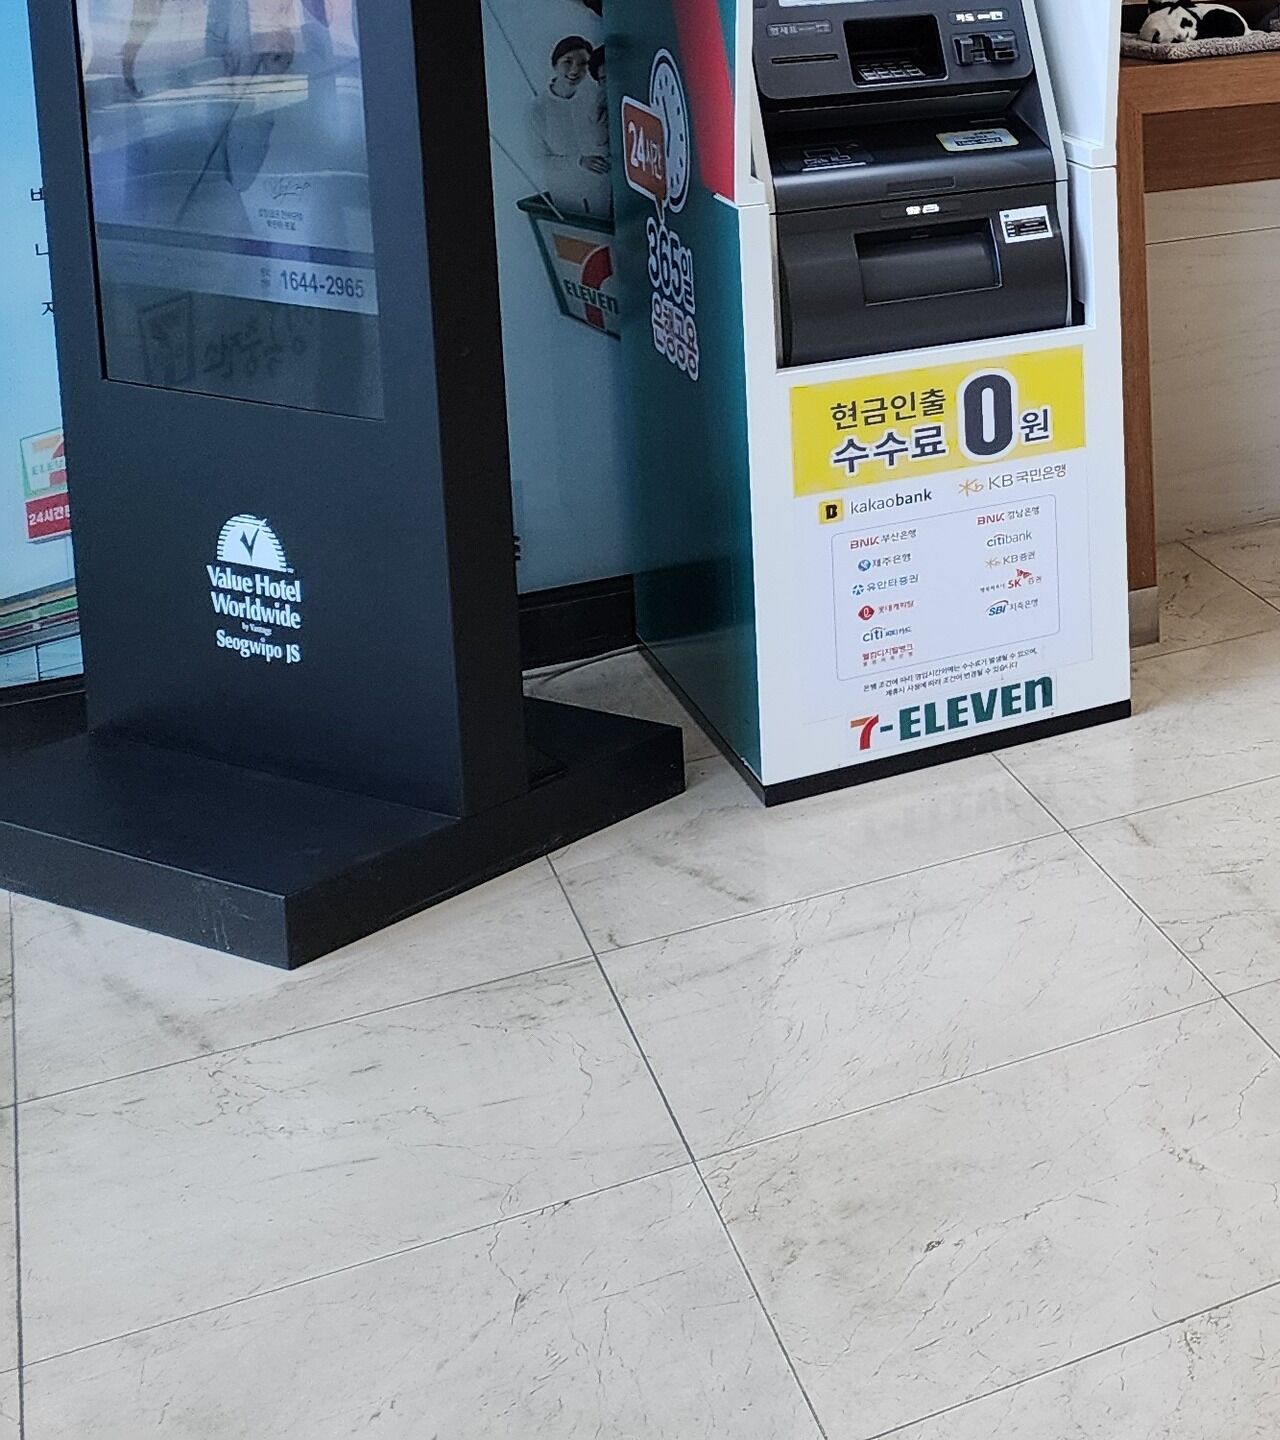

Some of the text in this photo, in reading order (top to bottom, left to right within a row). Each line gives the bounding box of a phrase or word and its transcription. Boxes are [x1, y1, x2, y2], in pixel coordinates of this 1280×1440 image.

[280, 269, 365, 299] 1644-2965
[830, 373, 1050, 456] 현금인출 0 원
[833, 425, 947, 473] 수수료
[850, 488, 932, 515] kakaobank
[986, 530, 1033, 548] citibank
[206, 564, 302, 603] Value Hotel
[210, 590, 302, 630] Worldwide
[215, 628, 284, 663] Seogwipo
